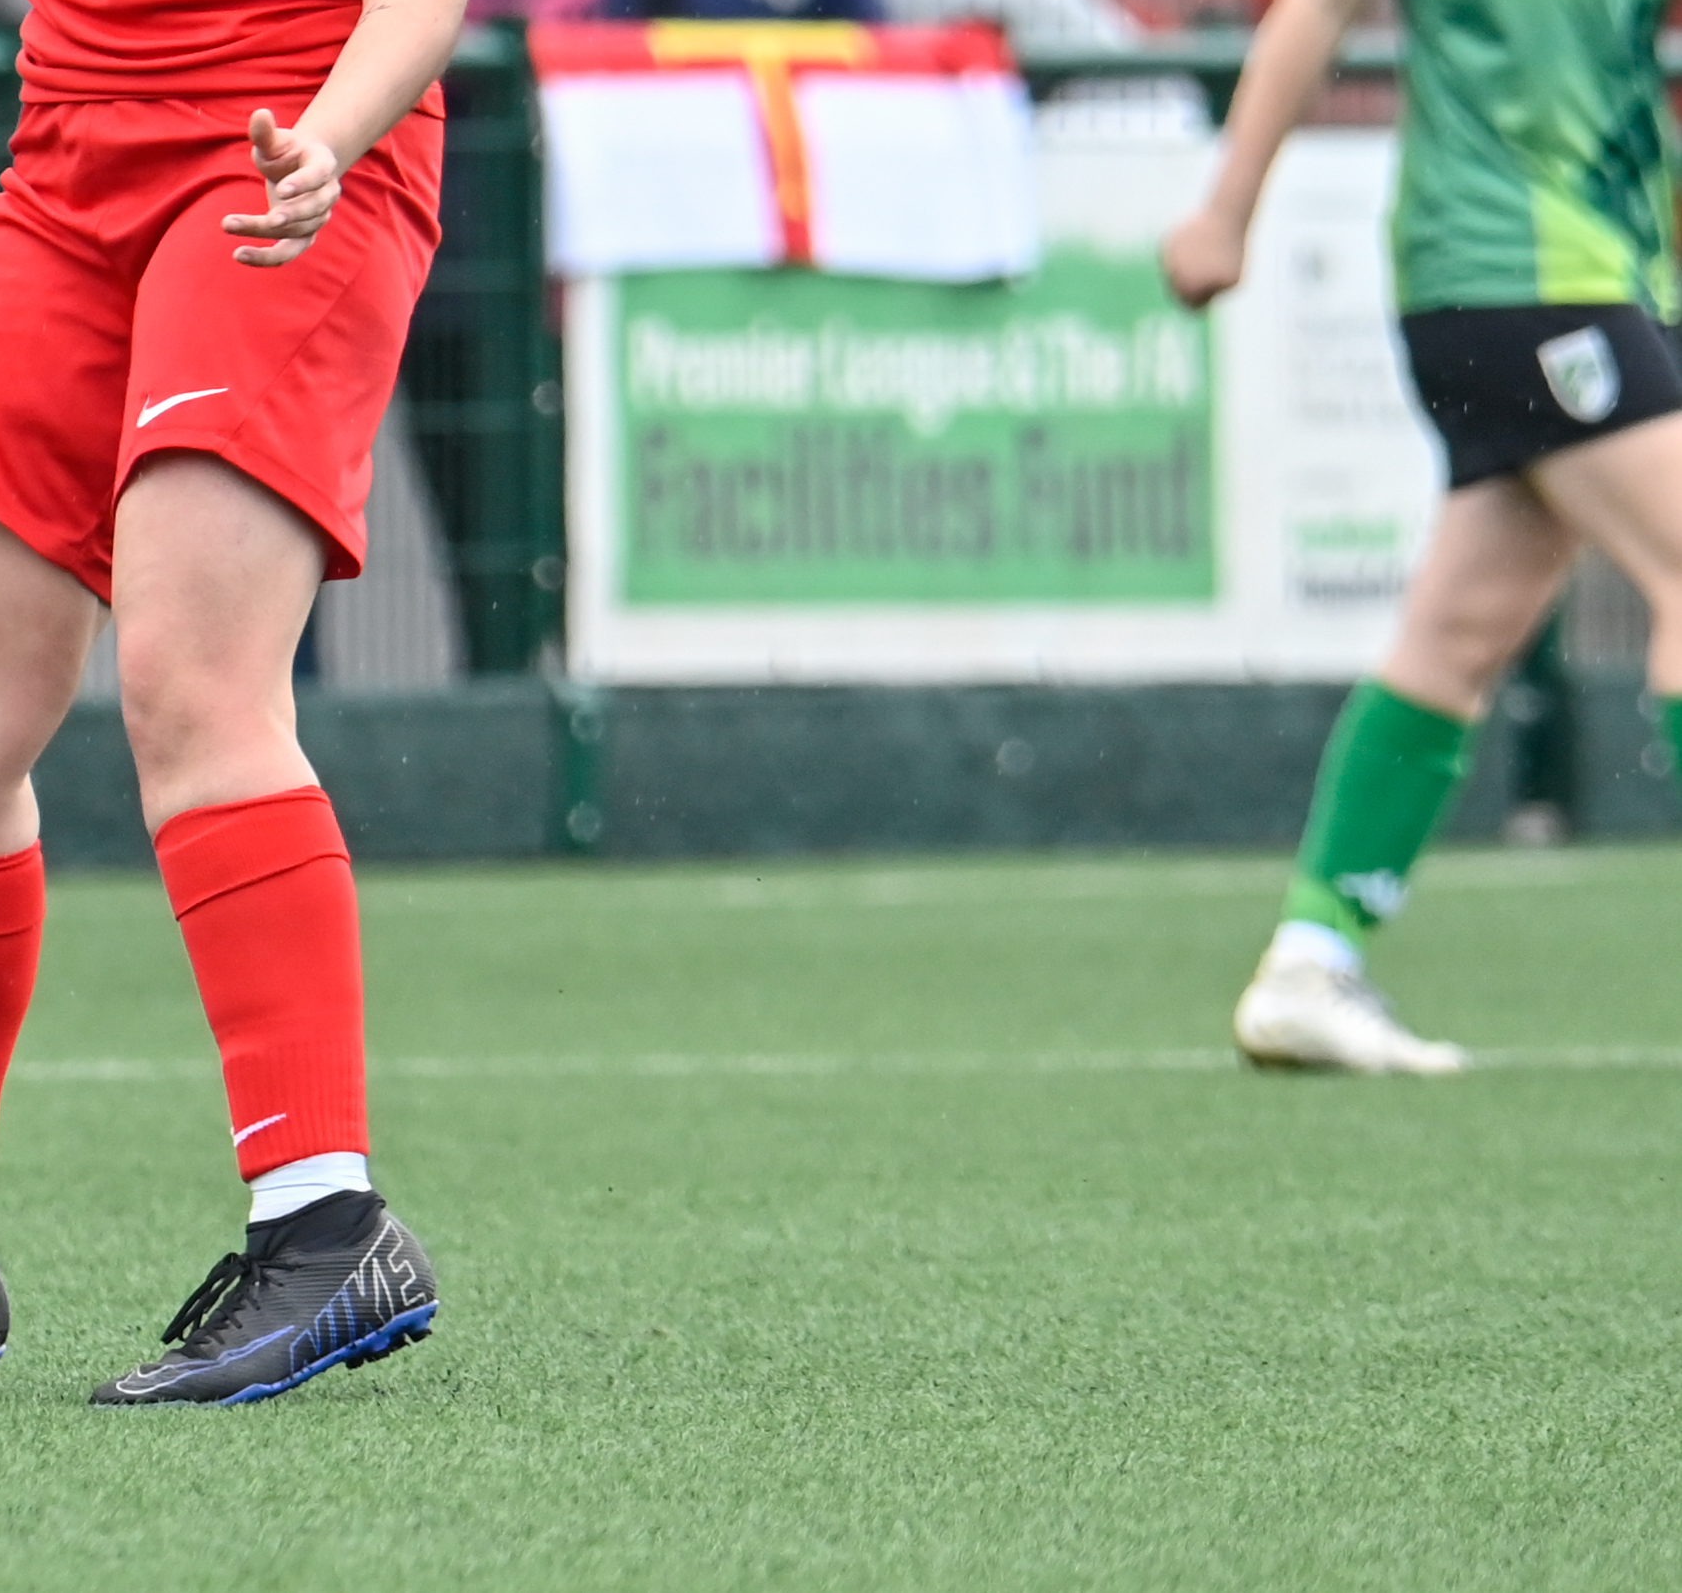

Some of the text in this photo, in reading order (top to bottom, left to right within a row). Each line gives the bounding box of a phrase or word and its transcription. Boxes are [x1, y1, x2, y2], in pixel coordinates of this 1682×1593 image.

[631, 315, 810, 404] Premier
[822, 315, 994, 433] League
[635, 423, 1196, 561] Facilities Fund
